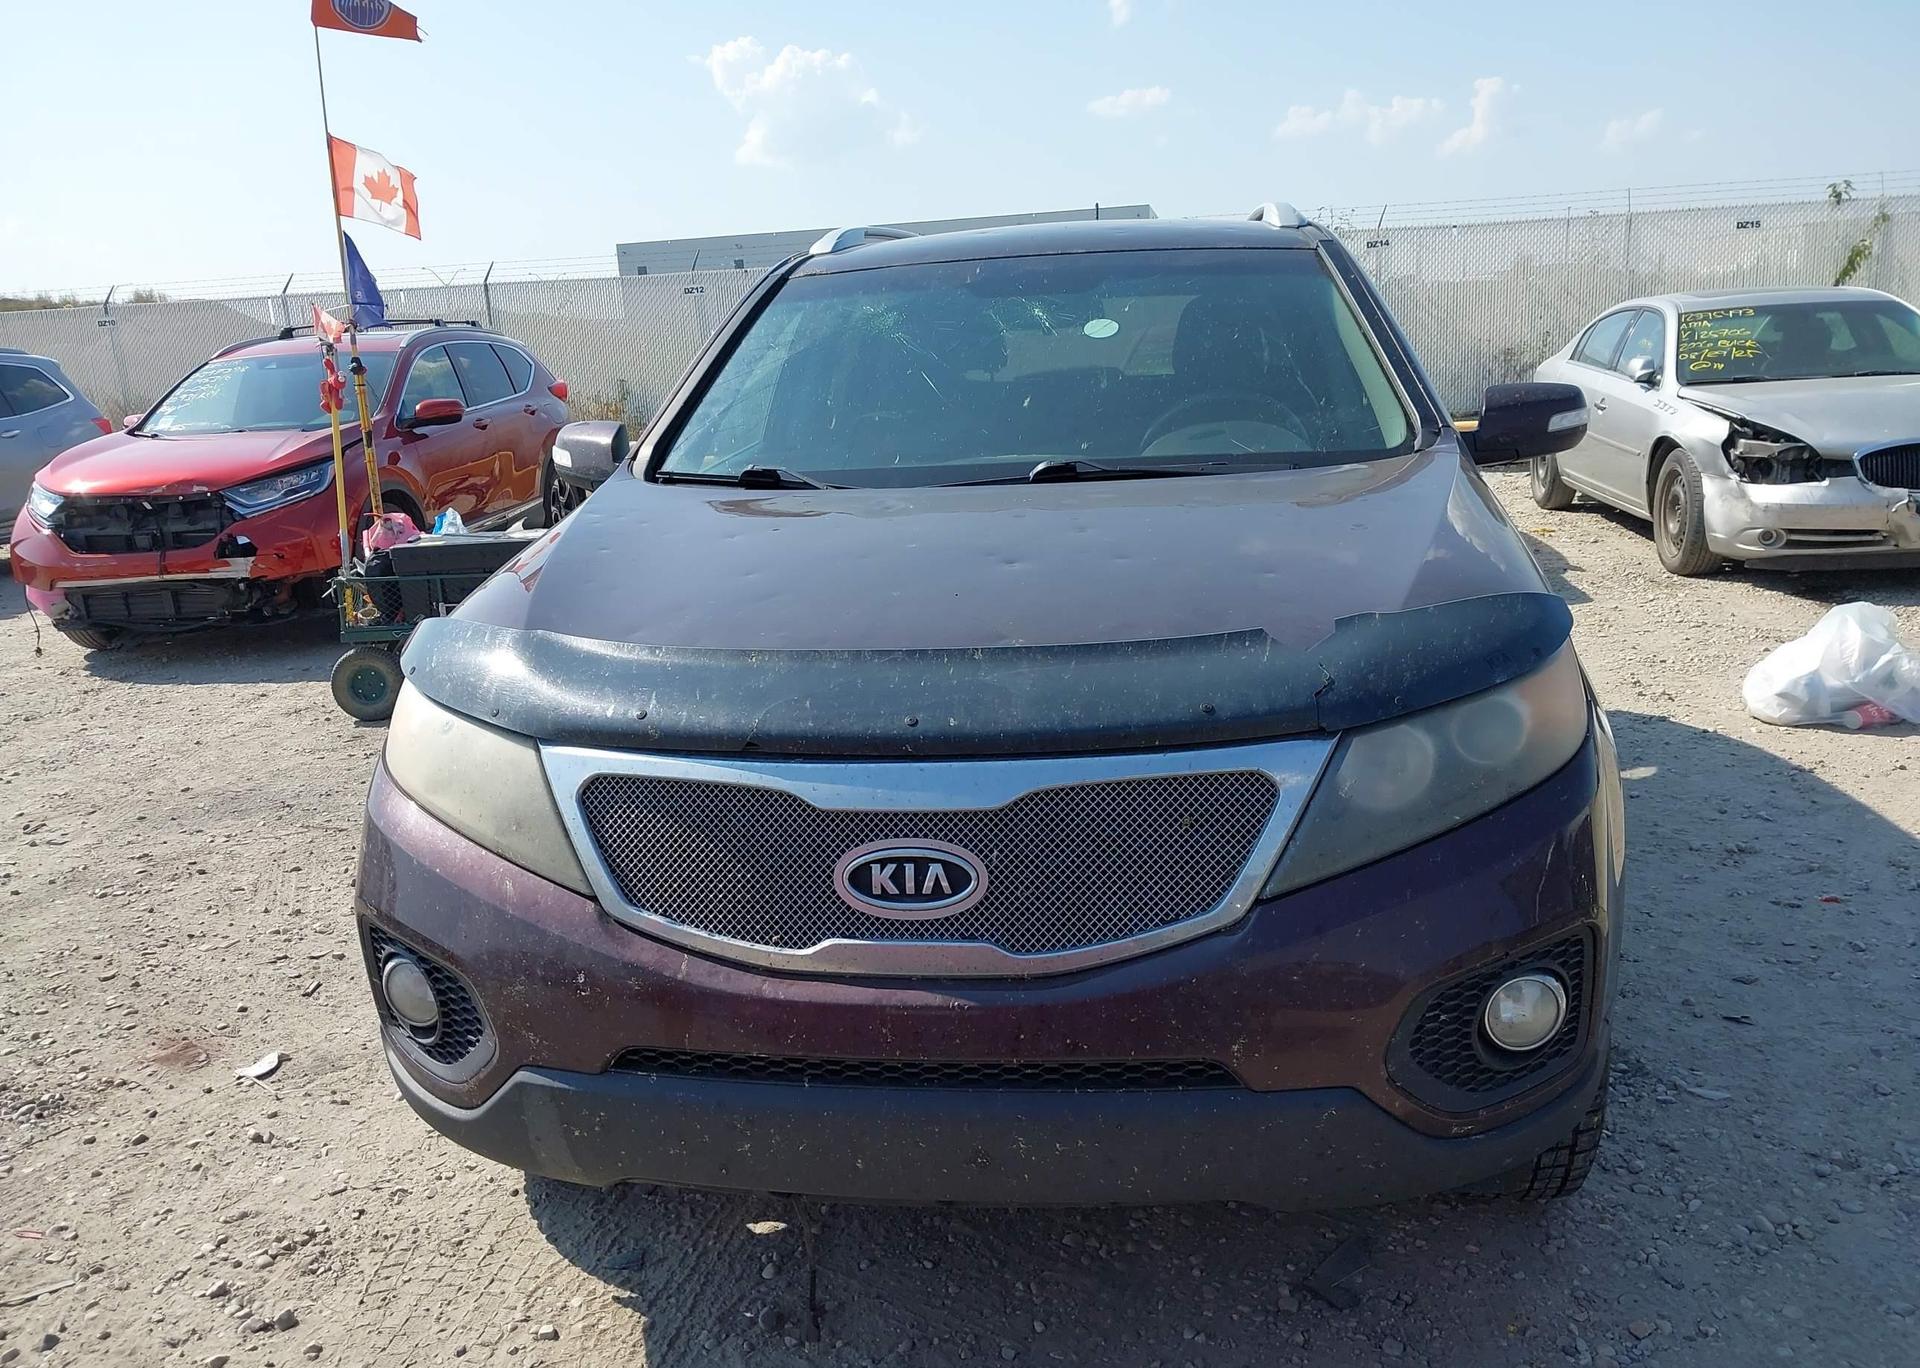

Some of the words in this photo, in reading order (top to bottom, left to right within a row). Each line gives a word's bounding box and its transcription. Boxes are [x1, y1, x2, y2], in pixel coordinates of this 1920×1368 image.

[1736, 220, 1761, 229] DZ15
[1366, 239, 1390, 249] DZ14
[684, 286, 705, 295] DZ12
[97, 319, 116, 327] DZ10
[869, 862, 953, 895] KIA
